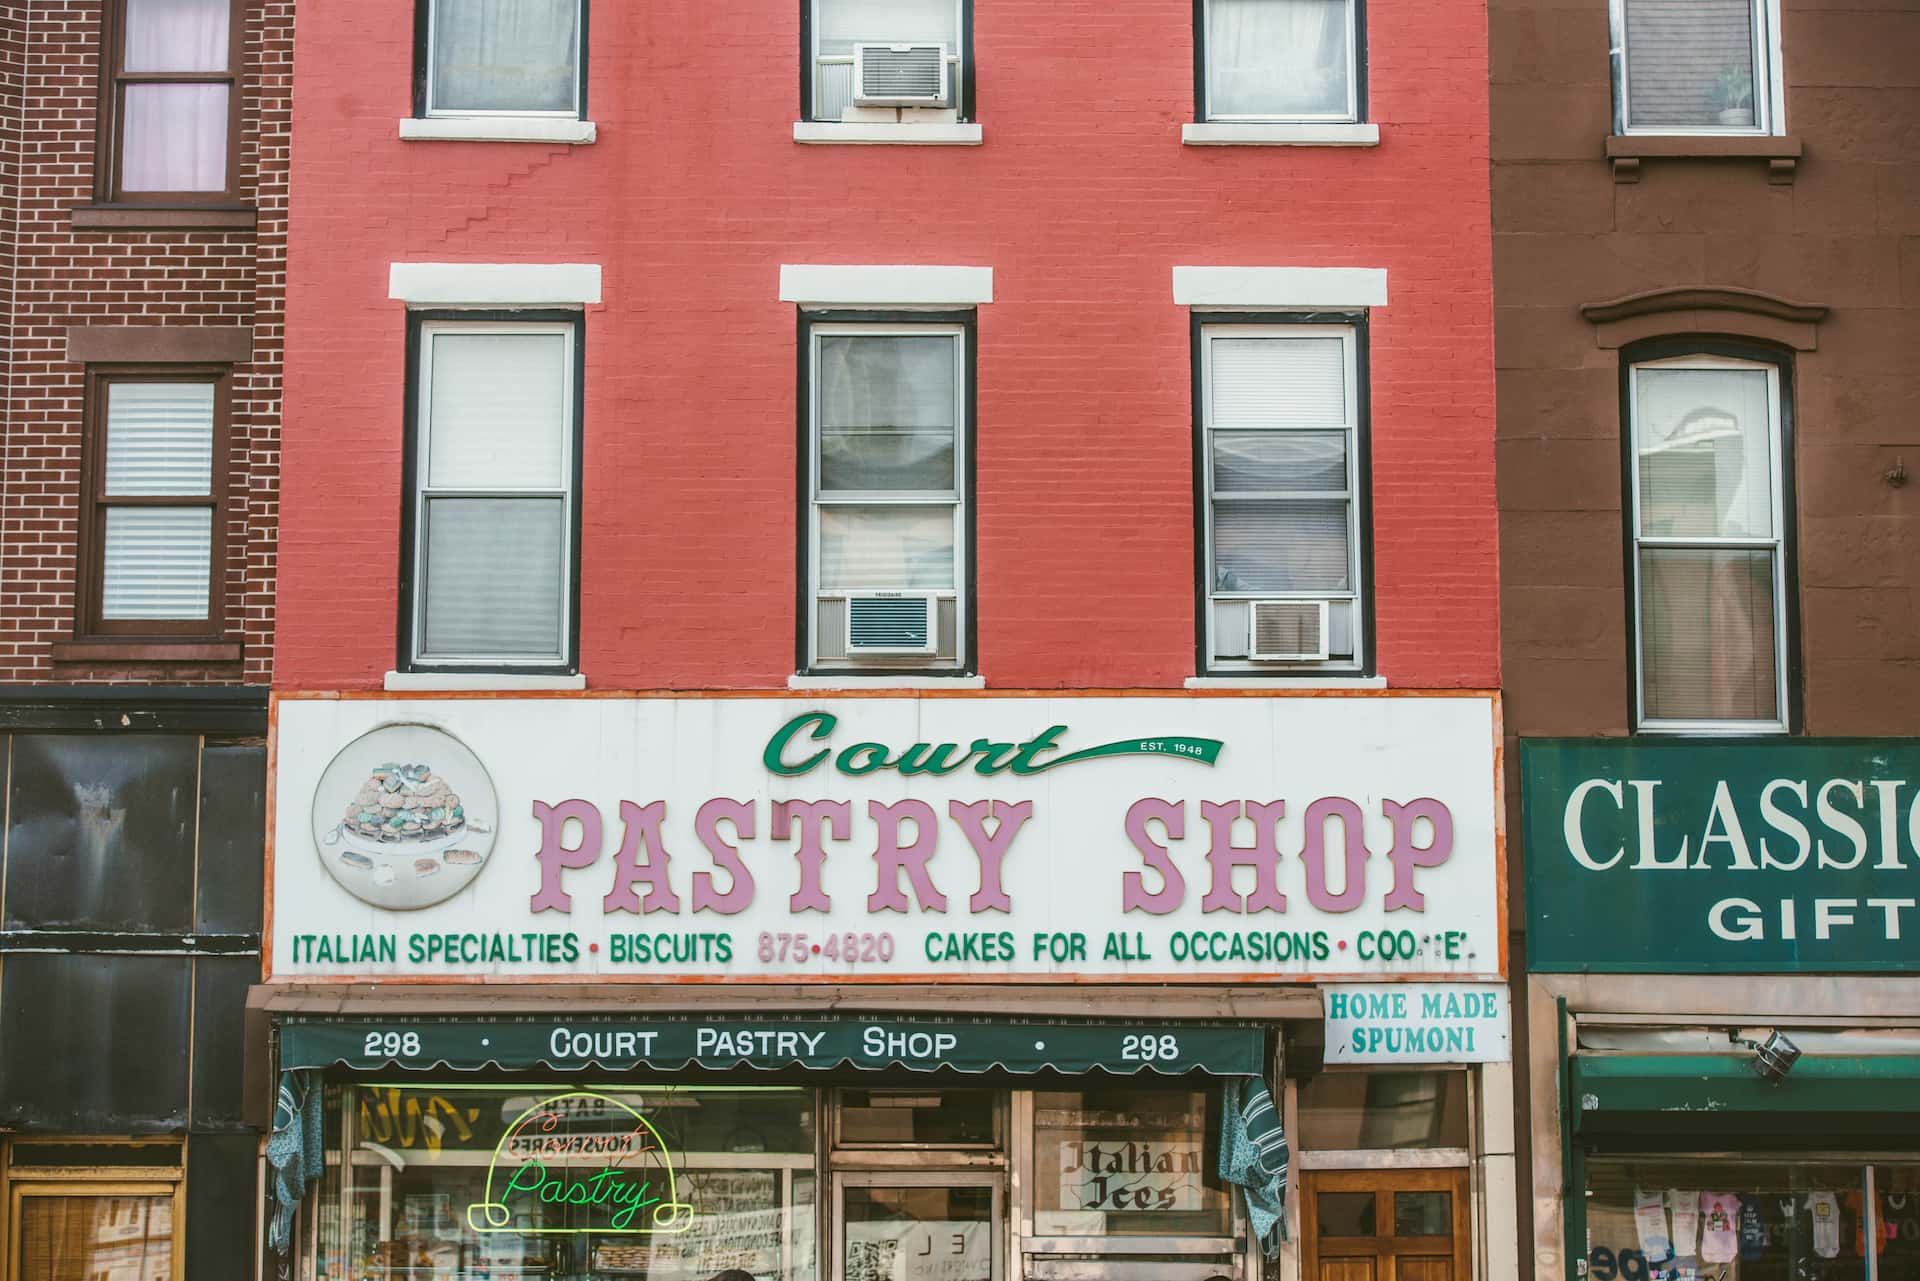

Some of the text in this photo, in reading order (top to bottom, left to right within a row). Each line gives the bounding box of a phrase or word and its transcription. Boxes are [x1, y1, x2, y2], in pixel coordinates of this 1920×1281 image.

[763, 711, 1069, 776] Court
[1140, 742, 1203, 755] EST. 1948
[1563, 778, 1920, 871] CLASSI
[530, 796, 1454, 915] PASTRY SHOP
[1707, 897, 1916, 941] GIFT
[292, 934, 397, 964] ITALIAN
[408, 933, 579, 964] SPECIALTIES
[609, 933, 733, 964] BISCUITS
[924, 932, 1015, 962] CAKES
[1033, 932, 1087, 962] FOR
[1103, 932, 1152, 961] ALL
[1169, 931, 1330, 961] OCCASIONS
[1330, 992, 1498, 1020] HOME MADE
[363, 1031, 421, 1057] 298
[1121, 1034, 1180, 1061] 298
[1352, 1026, 1476, 1054] SPUMONI
[1064, 1142, 1202, 1174] Italian
[501, 1160, 660, 1229] Pastry
